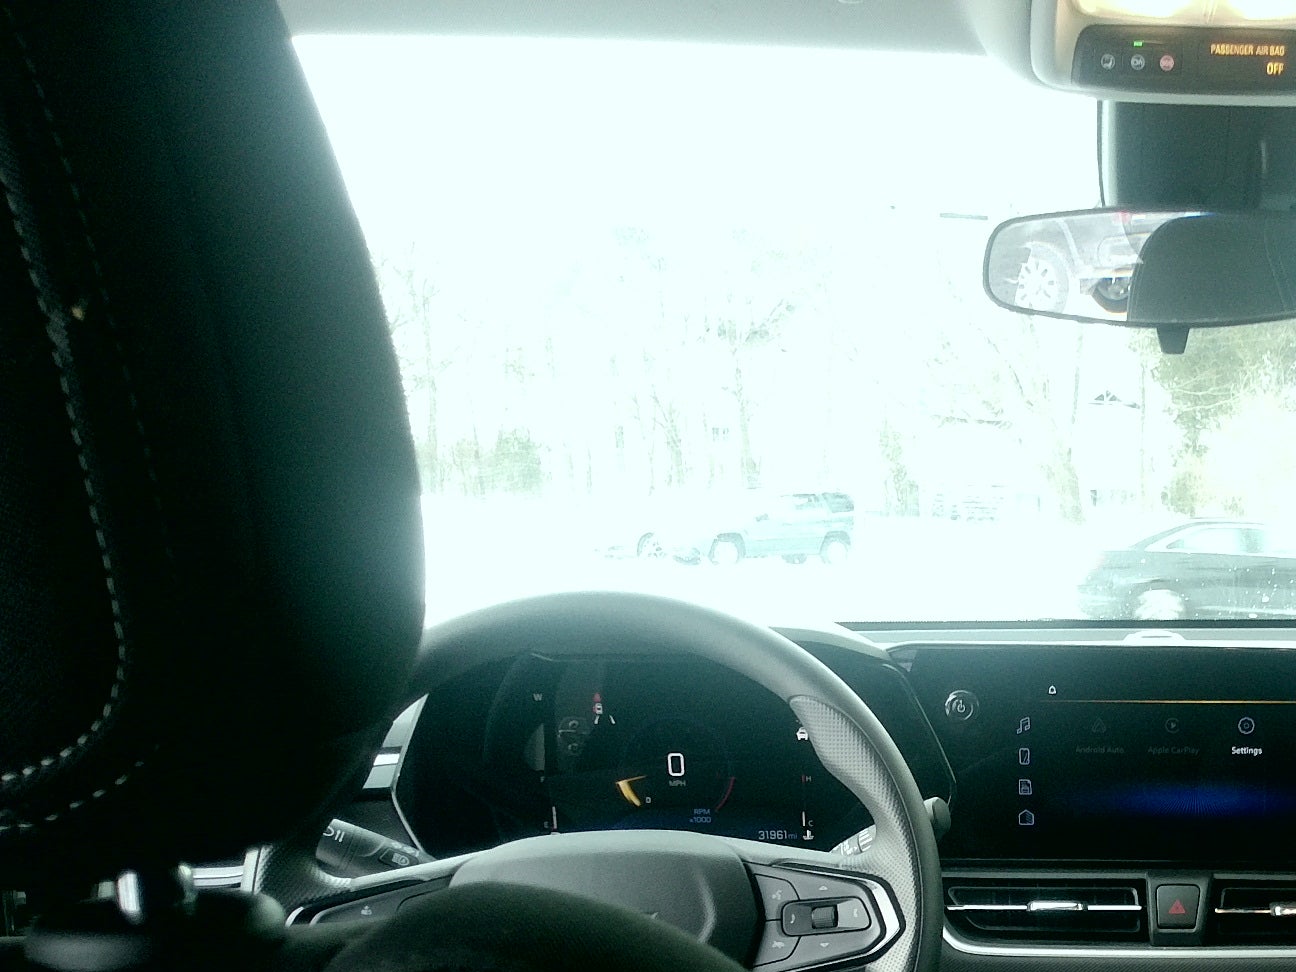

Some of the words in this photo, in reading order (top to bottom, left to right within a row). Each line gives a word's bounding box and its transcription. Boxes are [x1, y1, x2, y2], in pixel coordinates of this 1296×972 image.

[1210, 44, 1254, 56] PASSENGER
[1255, 44, 1269, 56] AIR
[1269, 45, 1286, 57] BAG
[1266, 62, 1285, 76] OFF
[533, 693, 543, 701] W
[1075, 745, 1105, 754] Android
[1106, 745, 1125, 754] Auto
[1147, 745, 1169, 756] Apple
[1170, 745, 1200, 756] CarPlay
[1231, 746, 1263, 757] Settings
[667, 752, 685, 777] 0
[669, 779, 687, 787] MPH
[693, 808, 711, 816] RPM
[758, 829, 788, 840] 31961
